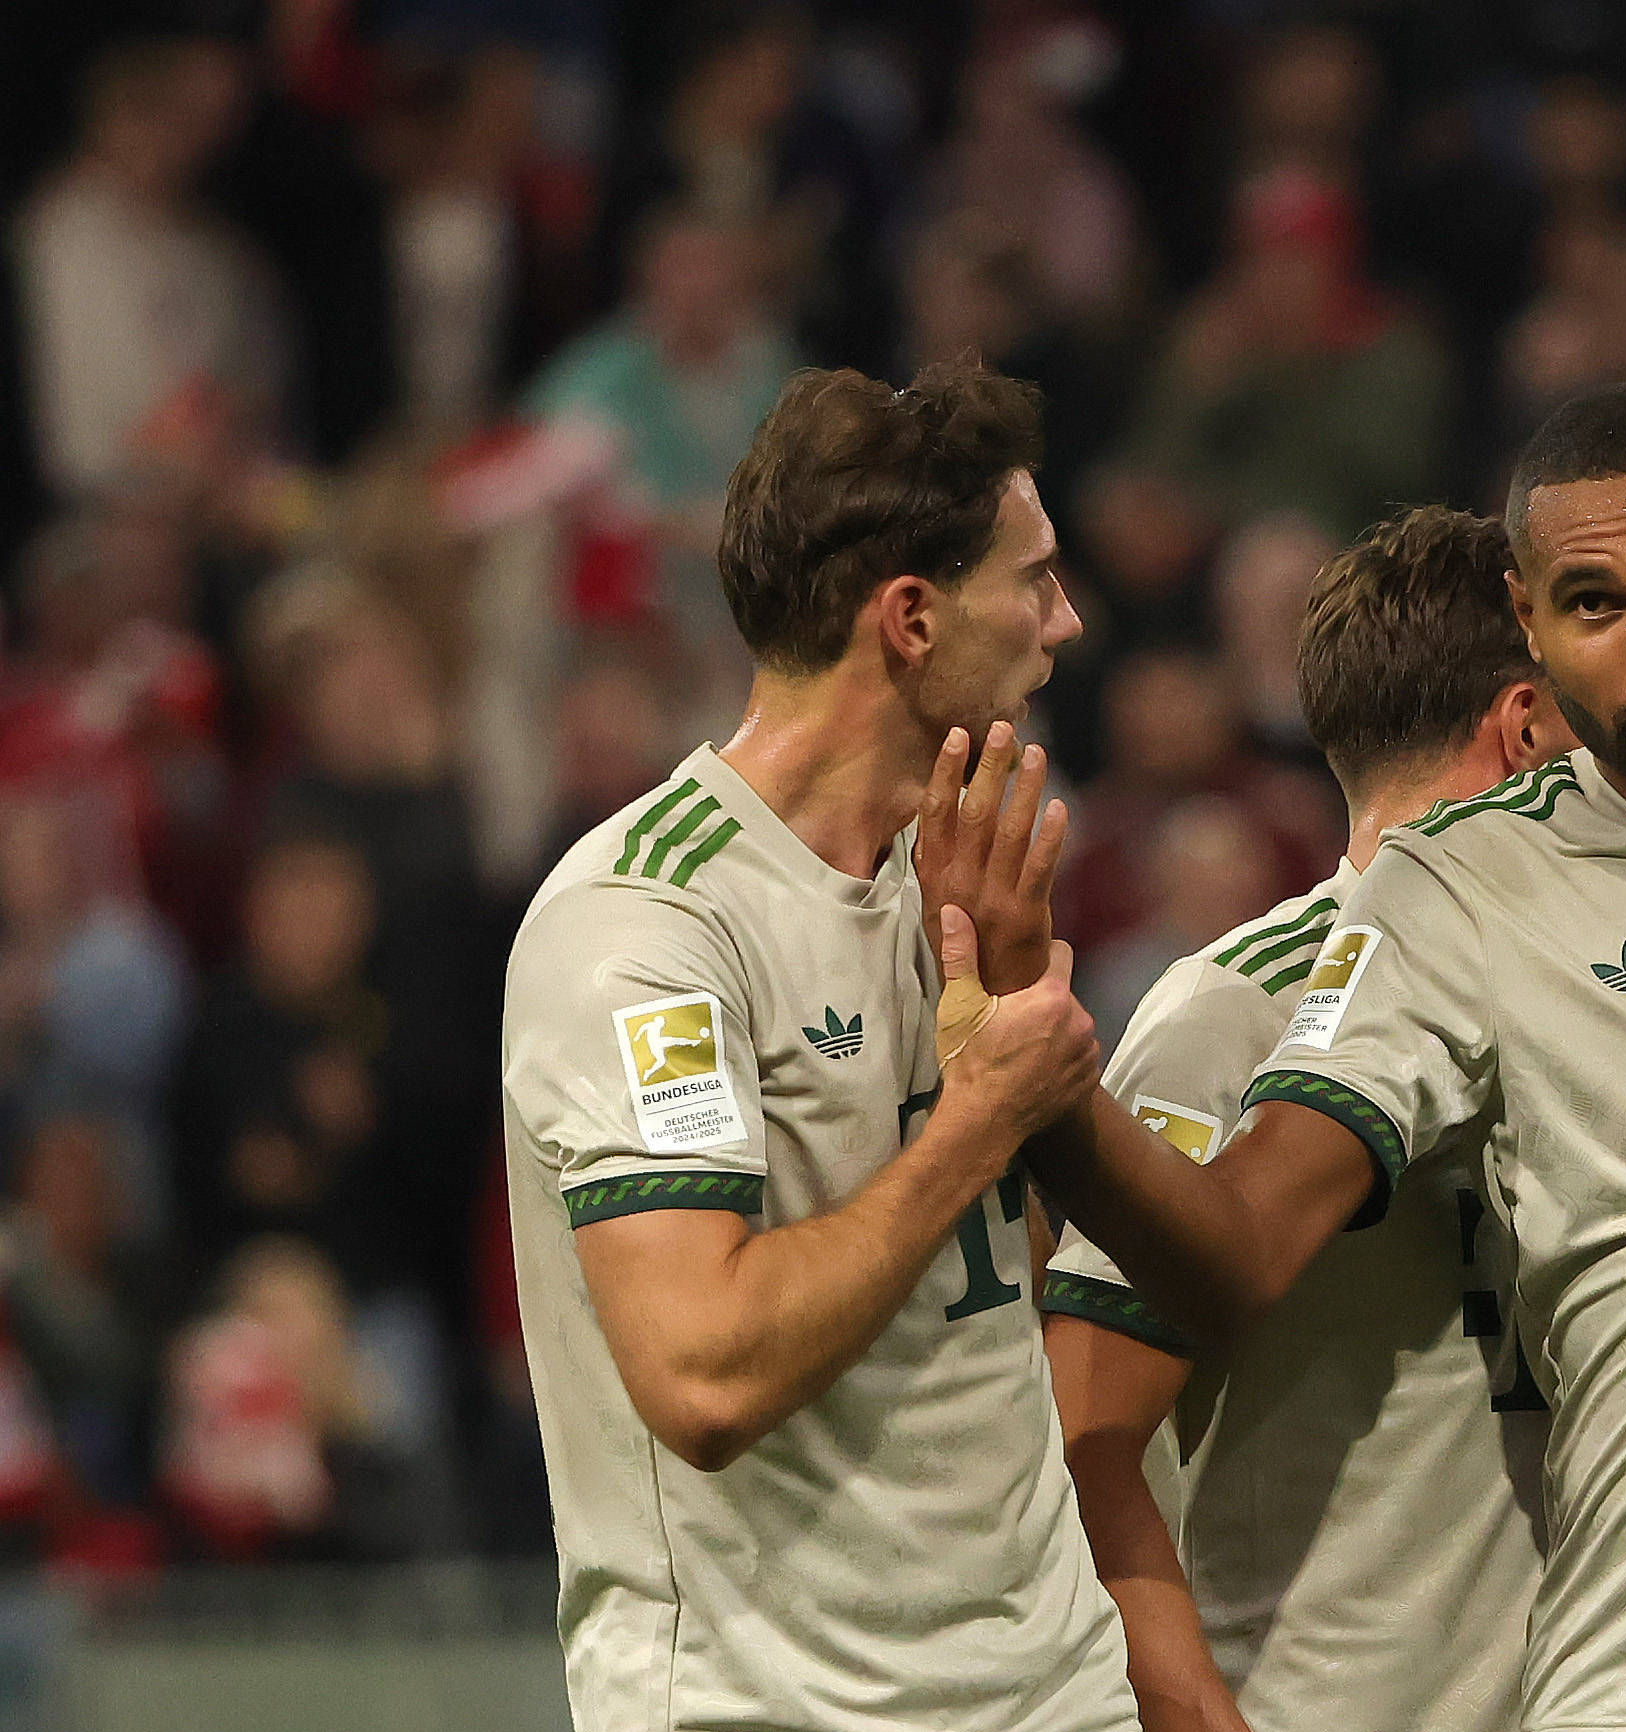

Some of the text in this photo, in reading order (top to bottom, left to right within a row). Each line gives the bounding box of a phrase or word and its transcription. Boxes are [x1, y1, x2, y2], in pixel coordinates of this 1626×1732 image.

[641, 1079, 723, 1106] BUNDESLIGA
[650, 1115, 734, 1139] FUSSBALLMEISTER
[664, 1108, 720, 1128] DEUTSCHER
